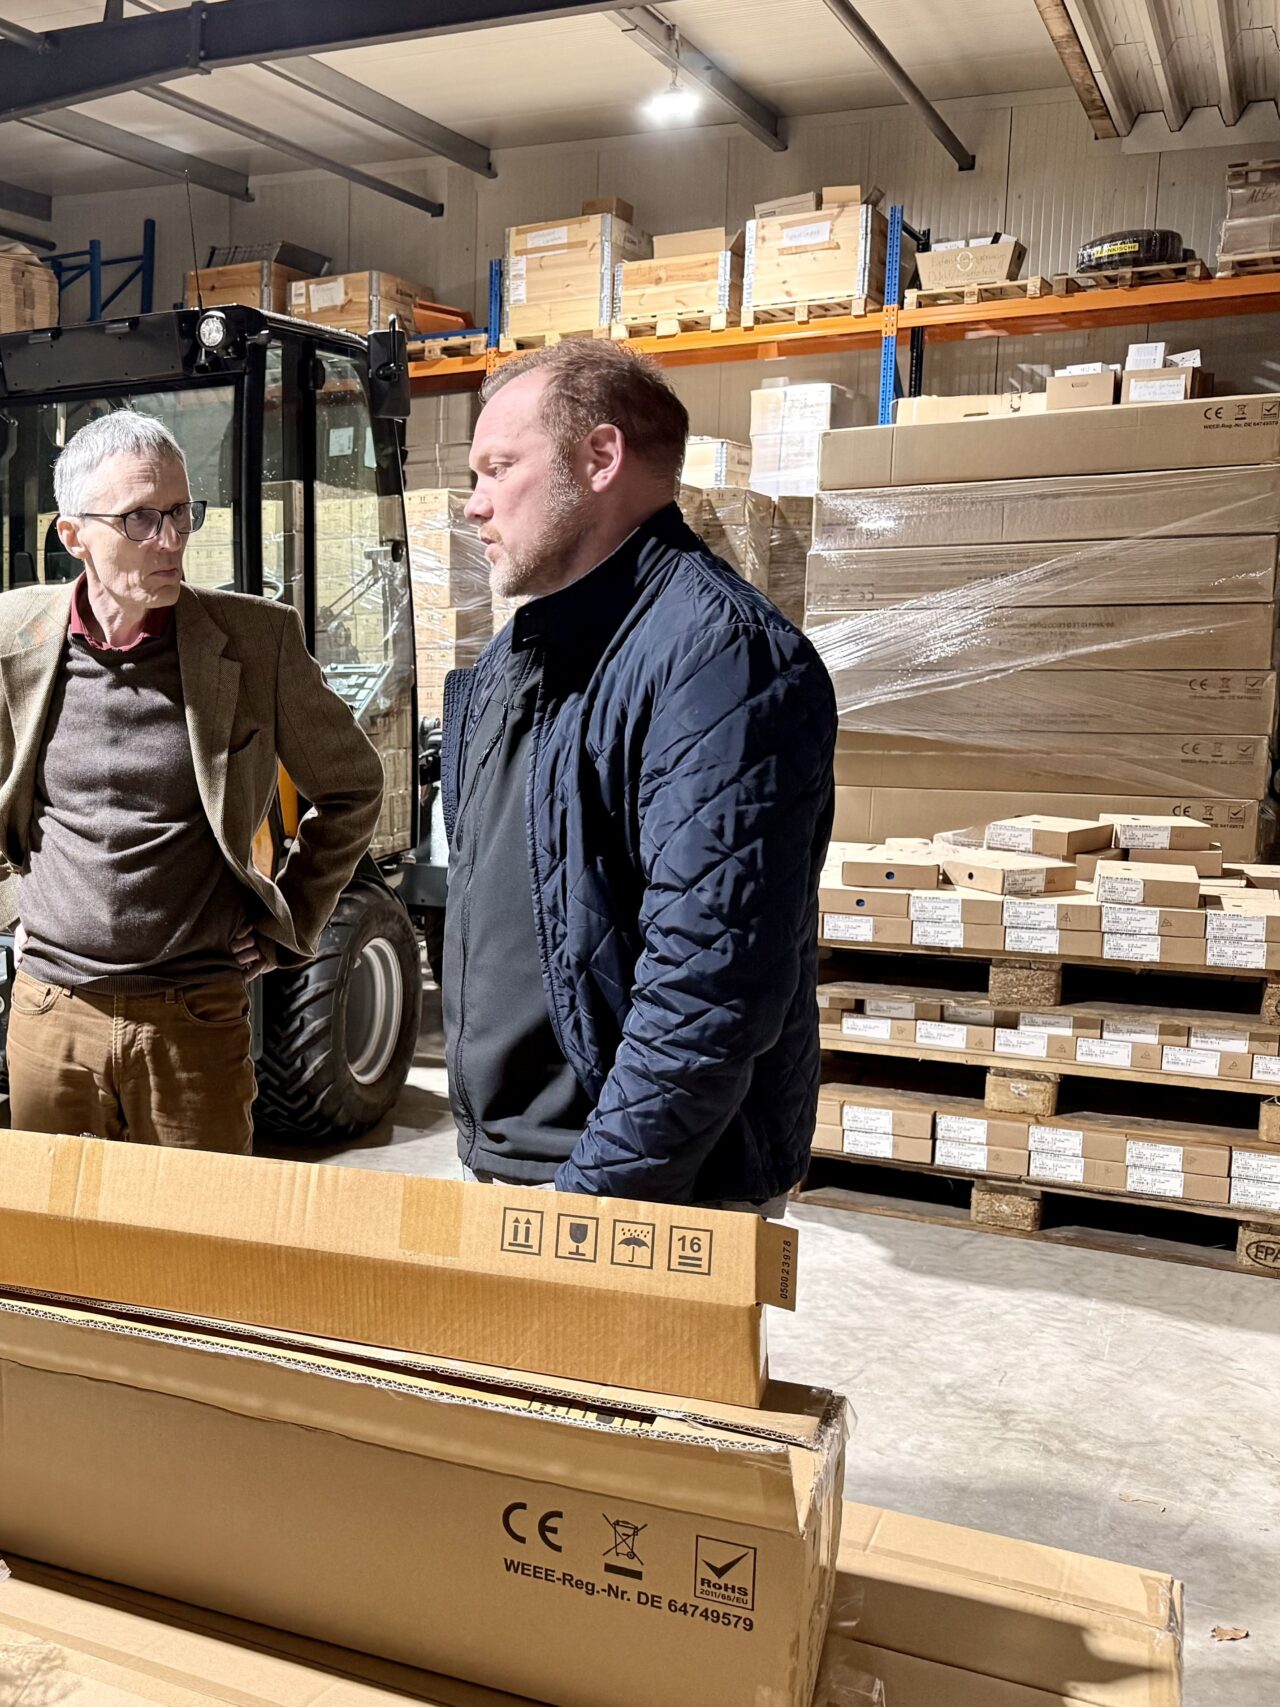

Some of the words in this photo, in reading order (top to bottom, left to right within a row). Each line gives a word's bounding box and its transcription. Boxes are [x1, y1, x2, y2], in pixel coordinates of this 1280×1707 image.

[1203, 406, 1224, 420] CE
[677, 1235, 702, 1253] 16
[502, 1501, 563, 1553] CE
[503, 1557, 631, 1601] WEEE-Reg.-Nr.
[637, 1591, 662, 1609] DE
[668, 1599, 754, 1632] 64749579
[700, 1578, 749, 1597] RoHS
[699, 1588, 749, 1606] 2011/65/EU
